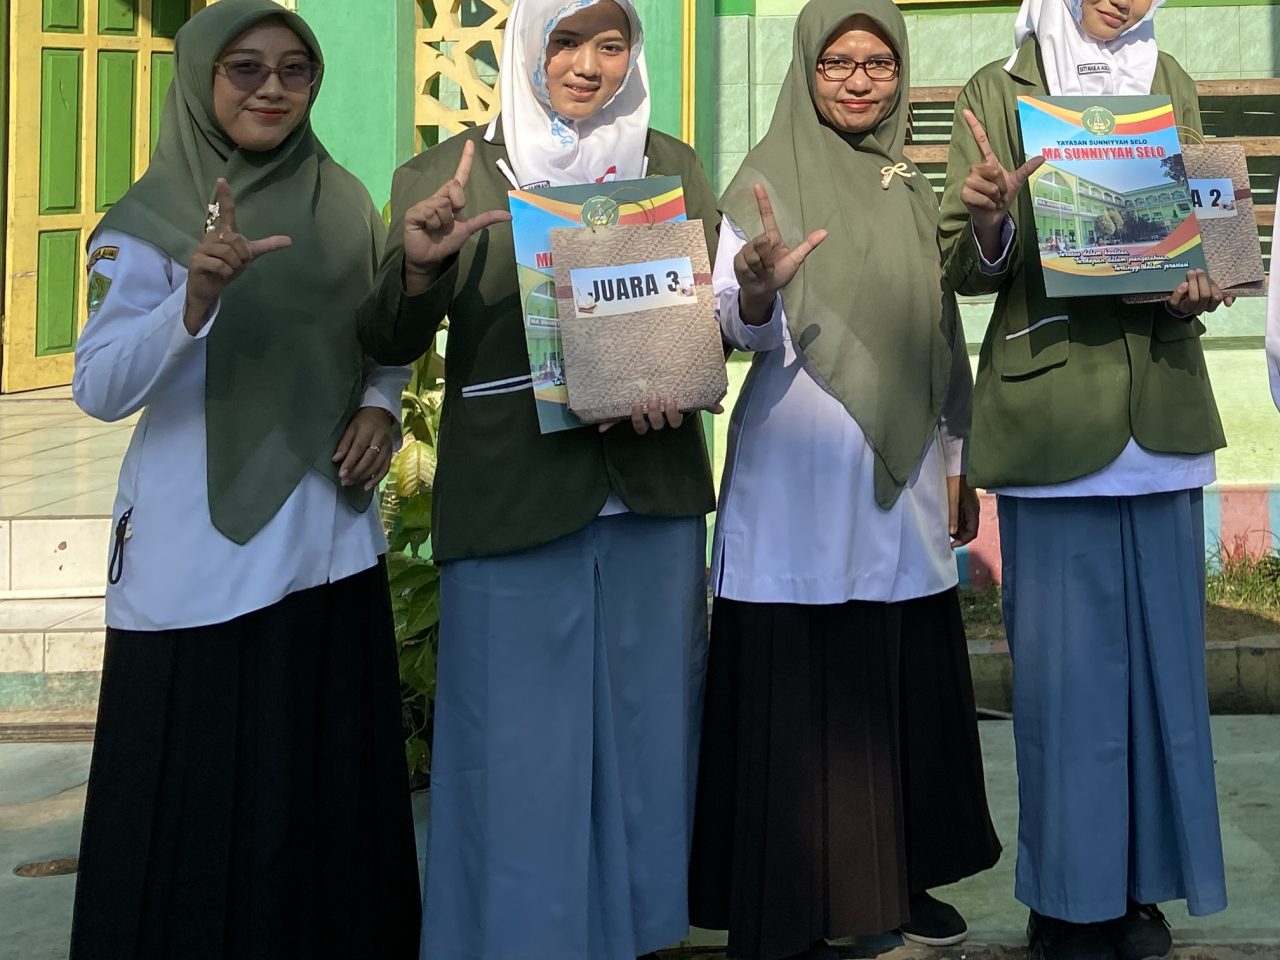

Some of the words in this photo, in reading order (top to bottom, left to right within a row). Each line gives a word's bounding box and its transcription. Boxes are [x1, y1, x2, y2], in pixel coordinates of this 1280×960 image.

[1042, 147, 1062, 160] MA
[1064, 147, 1135, 160] SUNNIYYAH
[1135, 145, 1166, 159] SELO
[1209, 188, 1221, 207] 2
[587, 273, 660, 303] JUARA
[665, 270, 680, 292] 3
